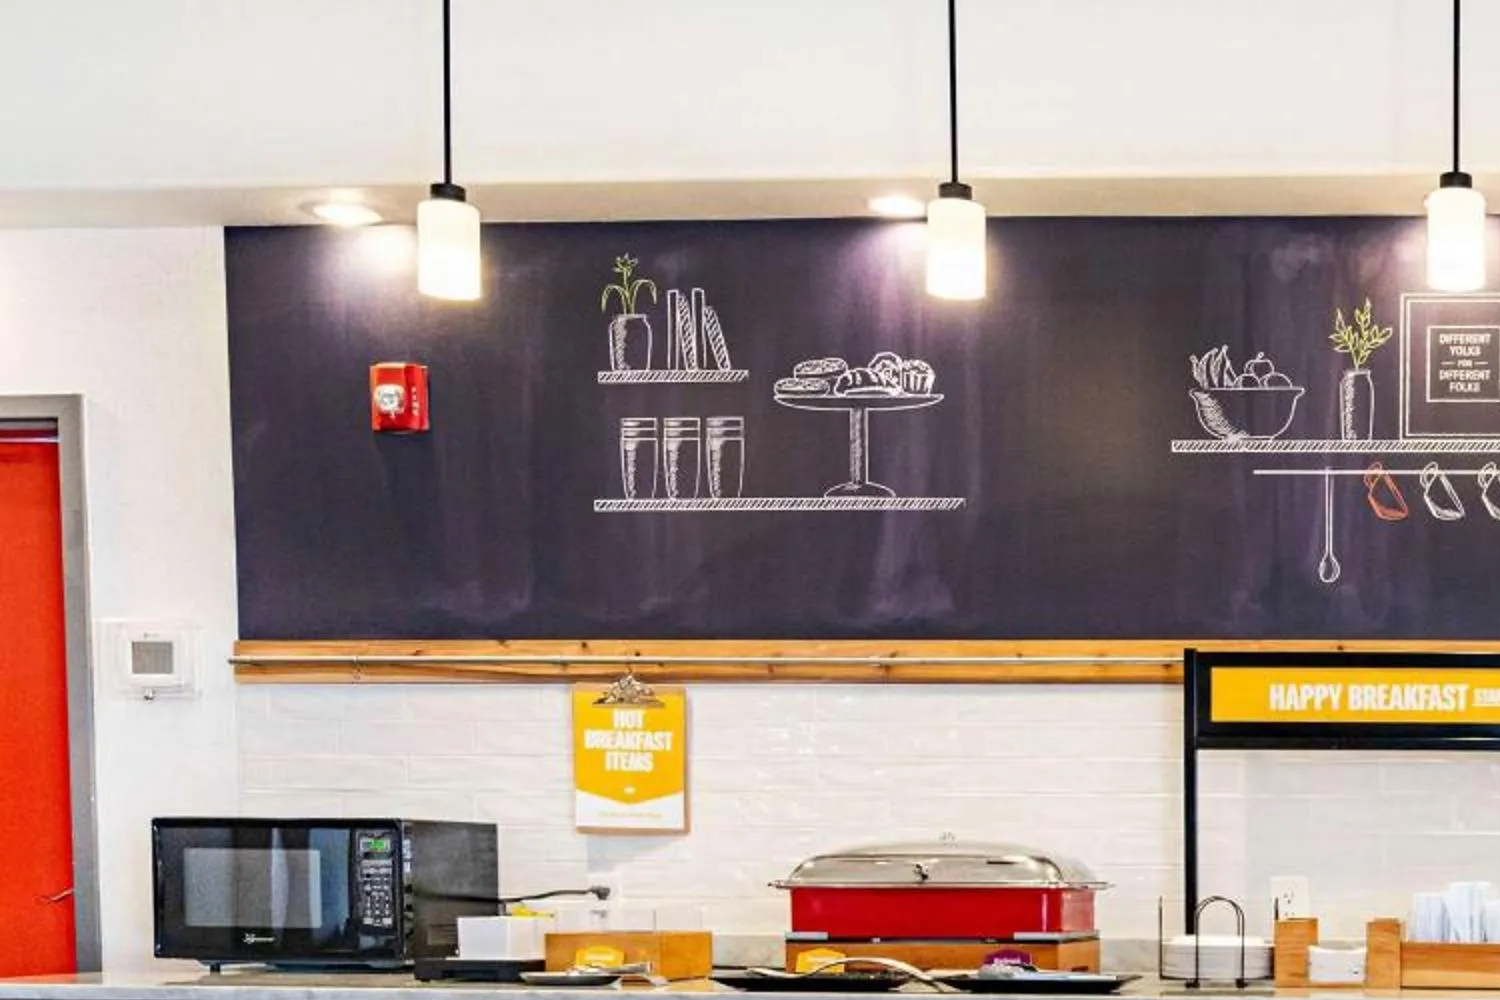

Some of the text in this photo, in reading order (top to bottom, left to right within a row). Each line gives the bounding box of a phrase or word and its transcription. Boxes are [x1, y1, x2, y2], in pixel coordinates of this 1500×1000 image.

[1439, 333, 1491, 345] DIFFERENT
[1450, 346, 1481, 357] YOLKS
[1439, 369, 1491, 381] DIFFERENT
[1450, 382, 1481, 393] FOLKS
[1269, 684, 1341, 711] HAPPY
[1349, 684, 1469, 712] BREAKFAST
[612, 709, 644, 728] HOT
[584, 729, 673, 751] BREAKFAST
[604, 751, 654, 772] ITEMS
